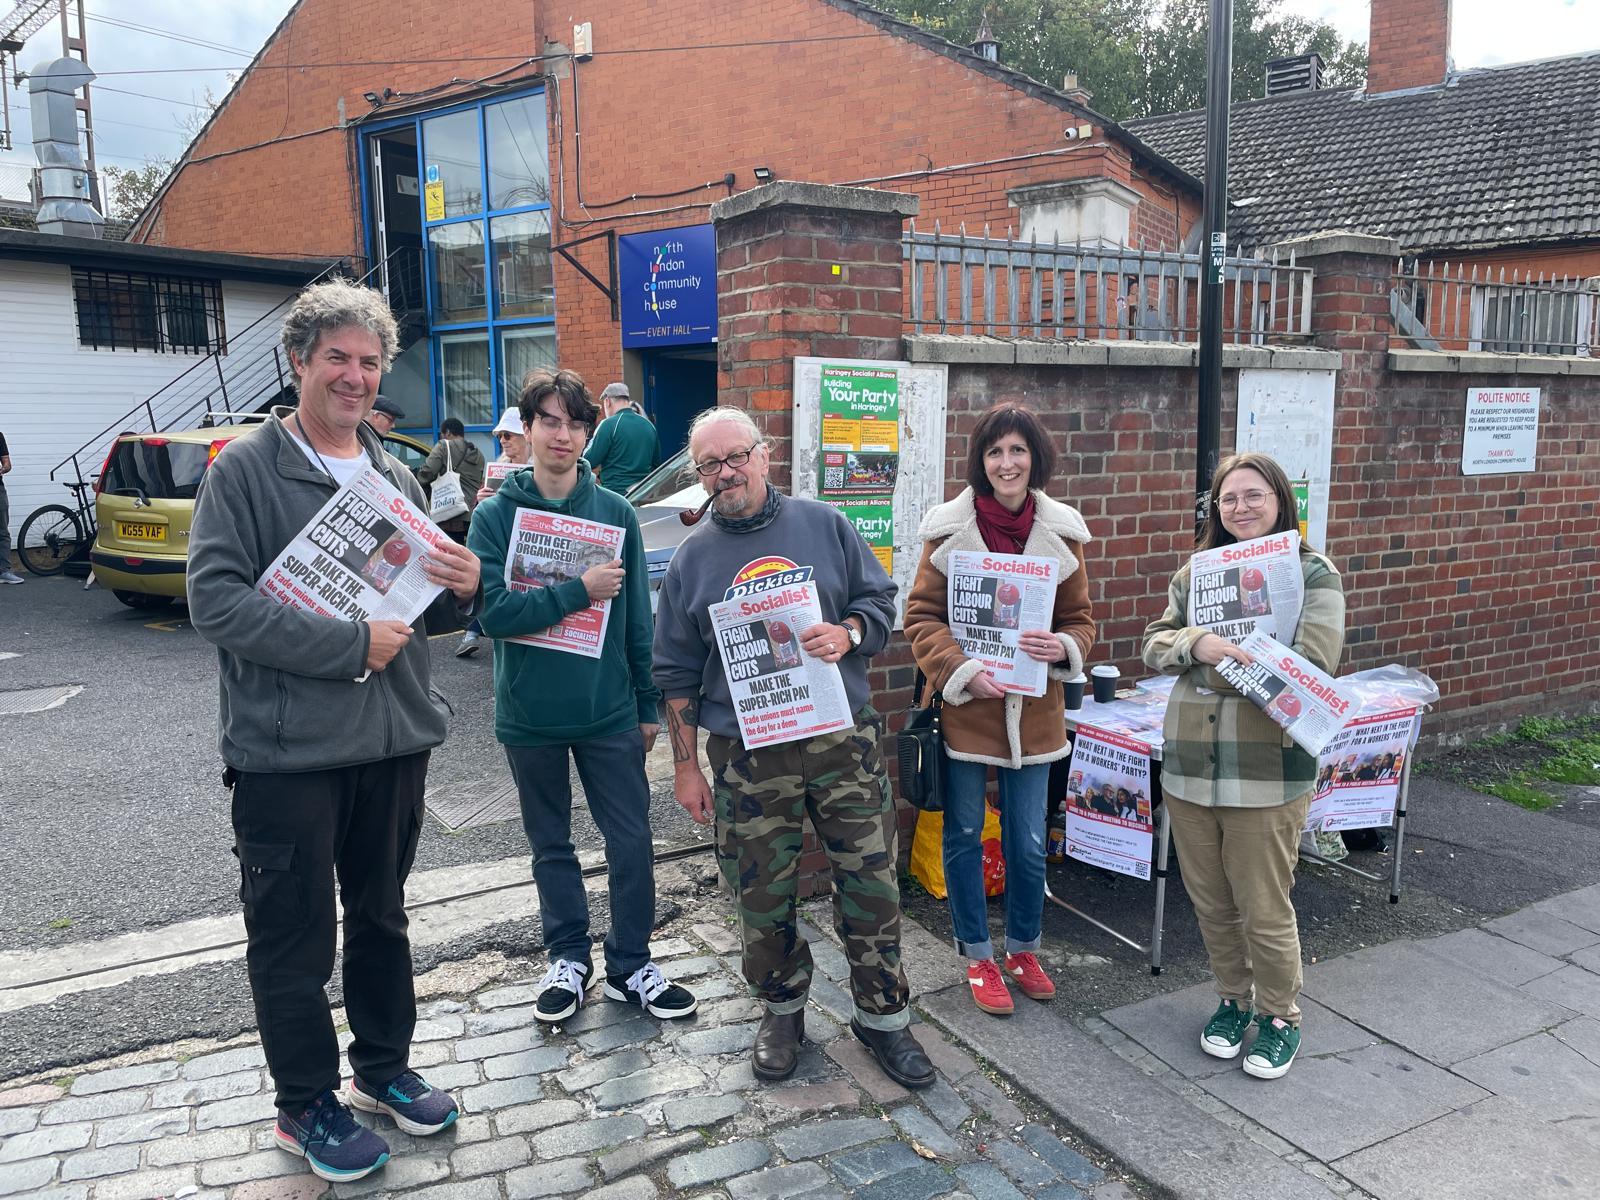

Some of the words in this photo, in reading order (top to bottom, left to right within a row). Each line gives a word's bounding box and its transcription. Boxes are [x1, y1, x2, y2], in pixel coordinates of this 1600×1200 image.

[654, 241, 683, 255] north
[650, 260, 684, 273] london
[1214, 257, 1222, 266] M
[644, 275, 701, 292] community
[644, 299, 677, 311] house
[647, 326, 671, 337] EVENT
[672, 324, 691, 334] HALL
[824, 369, 851, 377] Haringey
[824, 379, 852, 389] Building
[828, 387, 860, 402] Your
[862, 388, 896, 407] Party
[1478, 393, 1503, 403] POLITE
[1505, 392, 1530, 402] NOTICE
[850, 402, 857, 410] in
[858, 402, 887, 412] Haringey
[376, 492, 390, 506] the
[434, 497, 457, 509] Today
[338, 494, 382, 530] FIGHT
[122, 525, 143, 536] WG55
[146, 527, 162, 538] VAF
[324, 508, 378, 555] LABOUR
[539, 521, 551, 530] the
[551, 518, 619, 544] Socialist
[856, 517, 892, 532] Party
[311, 524, 349, 559] CUTS
[519, 531, 552, 547] YOUTH
[553, 538, 572, 550] GET
[860, 531, 882, 539] ringey
[516, 542, 576, 564] ORGANISED!
[1222, 536, 1290, 563] Socialist
[310, 554, 345, 585] MAKE
[342, 575, 365, 600] THE
[970, 561, 982, 570] the
[982, 558, 1051, 577] Socialist
[273, 569, 293, 589] Trade
[292, 587, 316, 608] unions
[282, 555, 349, 612] SUPER-RICH
[344, 602, 370, 622] PAY
[733, 571, 804, 599] Dickies
[954, 575, 983, 592] FIGHT
[1196, 572, 1225, 591] FIGHT
[265, 579, 278, 592] the
[277, 590, 291, 606] day
[954, 591, 992, 610] LABOUR
[1196, 586, 1238, 608] LABOUR
[732, 609, 743, 619] the
[741, 586, 810, 616] Socialist
[953, 607, 978, 624] CUTS
[1196, 605, 1224, 624] CUTS
[564, 630, 598, 643] SOCIALISM
[721, 624, 754, 646] FIGHT
[966, 627, 988, 641] MAKE
[988, 630, 1002, 643] THE
[1212, 622, 1237, 638] MAKE
[1238, 620, 1256, 634] THE
[726, 638, 770, 663] LABOUR
[1000, 647, 1016, 659] PAY
[730, 660, 760, 680] CUTS
[997, 660, 1014, 671] name
[1244, 662, 1273, 684] GHT
[749, 677, 774, 695] MAKE
[776, 673, 792, 689] THE
[1229, 662, 1272, 701] LABOUR
[1279, 657, 1350, 714] Socialist
[739, 690, 792, 713] SUPER-RICH
[793, 685, 810, 702] PAY
[742, 716, 759, 725] Trade
[760, 711, 779, 722] unions
[780, 706, 795, 717] must
[796, 704, 814, 713] name
[746, 727, 756, 736] the
[757, 725, 768, 735] day
[768, 722, 777, 731] for
[782, 719, 797, 728] demo
[1340, 730, 1352, 741] FIGHT
[1355, 728, 1370, 736] WHAT
[1370, 726, 1382, 734] NEXT
[1389, 722, 1397, 730] THE
[1398, 720, 1411, 729] FIGHT
[1333, 741, 1349, 752] PARTY?
[1351, 738, 1361, 746] FOR
[1368, 734, 1391, 743] WORKERS'
[1392, 729, 1409, 739] PARTY?
[1078, 739, 1092, 750] WHAT
[1094, 743, 1108, 757] NEXT
[1108, 749, 1114, 759] IN
[1116, 751, 1126, 763] THE
[1128, 756, 1146, 767] FIGHT
[1075, 750, 1084, 760] FOR
[1091, 755, 1120, 771] WORKERS'
[1122, 765, 1147, 778] PARTY?
[1088, 812, 1102, 820] PUBLIC
[1103, 816, 1121, 825] MEETING
[1085, 856, 1131, 871] socialistparty.org.uk
